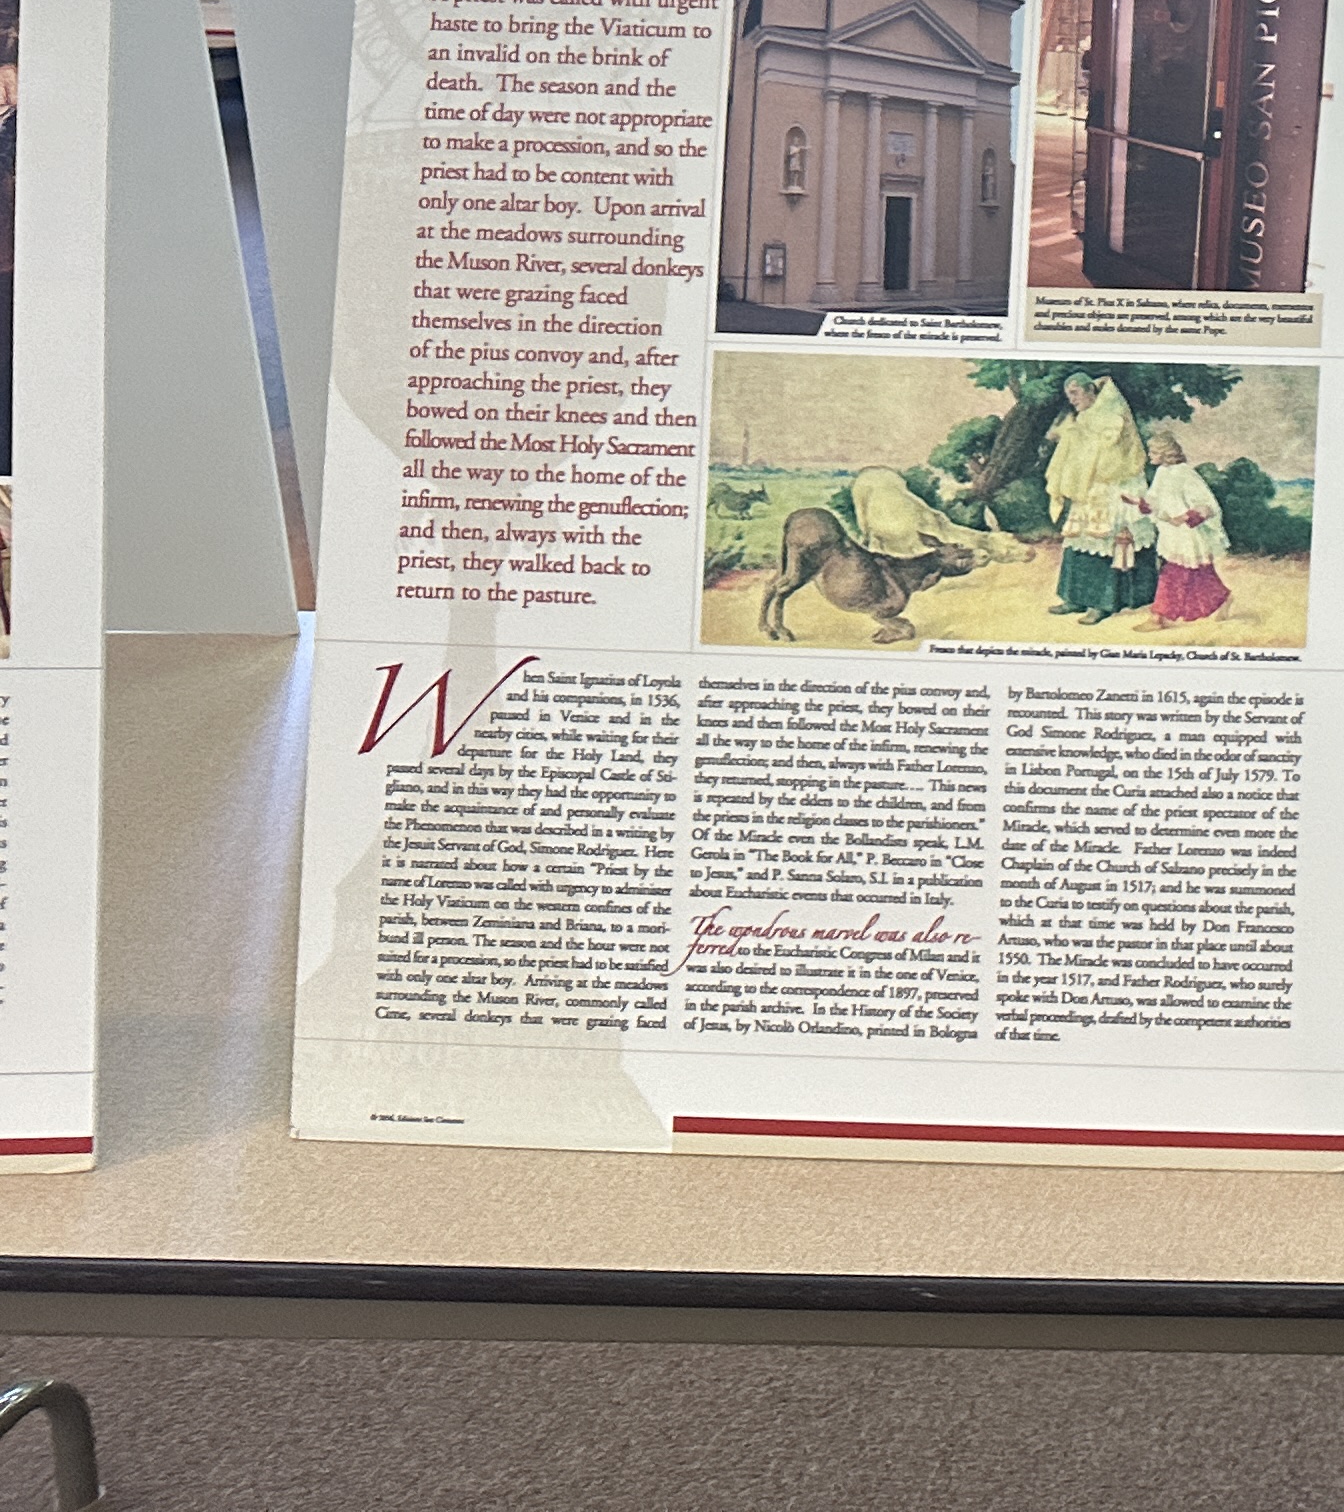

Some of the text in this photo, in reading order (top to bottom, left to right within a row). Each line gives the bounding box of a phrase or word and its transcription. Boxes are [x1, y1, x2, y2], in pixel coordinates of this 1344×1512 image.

[430, 12, 712, 41] haste to bring the Viaticum to
[428, 43, 669, 67] an invalid on the brink of
[426, 70, 676, 97] death. The season and the
[1250, 62, 1276, 141] SAN
[424, 102, 713, 133] time of day were not appropriate
[422, 131, 708, 159] to make a procession, and so the
[421, 161, 674, 186] priest had to be content with
[1005, 765, 1017, 775] in
[1021, 765, 1062, 777] Lisbon
[1122, 770, 1139, 779] on
[1144, 767, 1163, 779] the
[1168, 768, 1195, 780] 15th
[1199, 768, 1214, 780] of
[1213, 768, 1240, 784] July
[1283, 769, 1301, 782] To
[689, 887, 955, 909] about Eucharistic events that occurred in Italy.
[690, 905, 733, 937] The
[728, 909, 806, 938] wondrous
[811, 912, 882, 939] marvel
[874, 928, 908, 942] was
[911, 915, 950, 944] also
